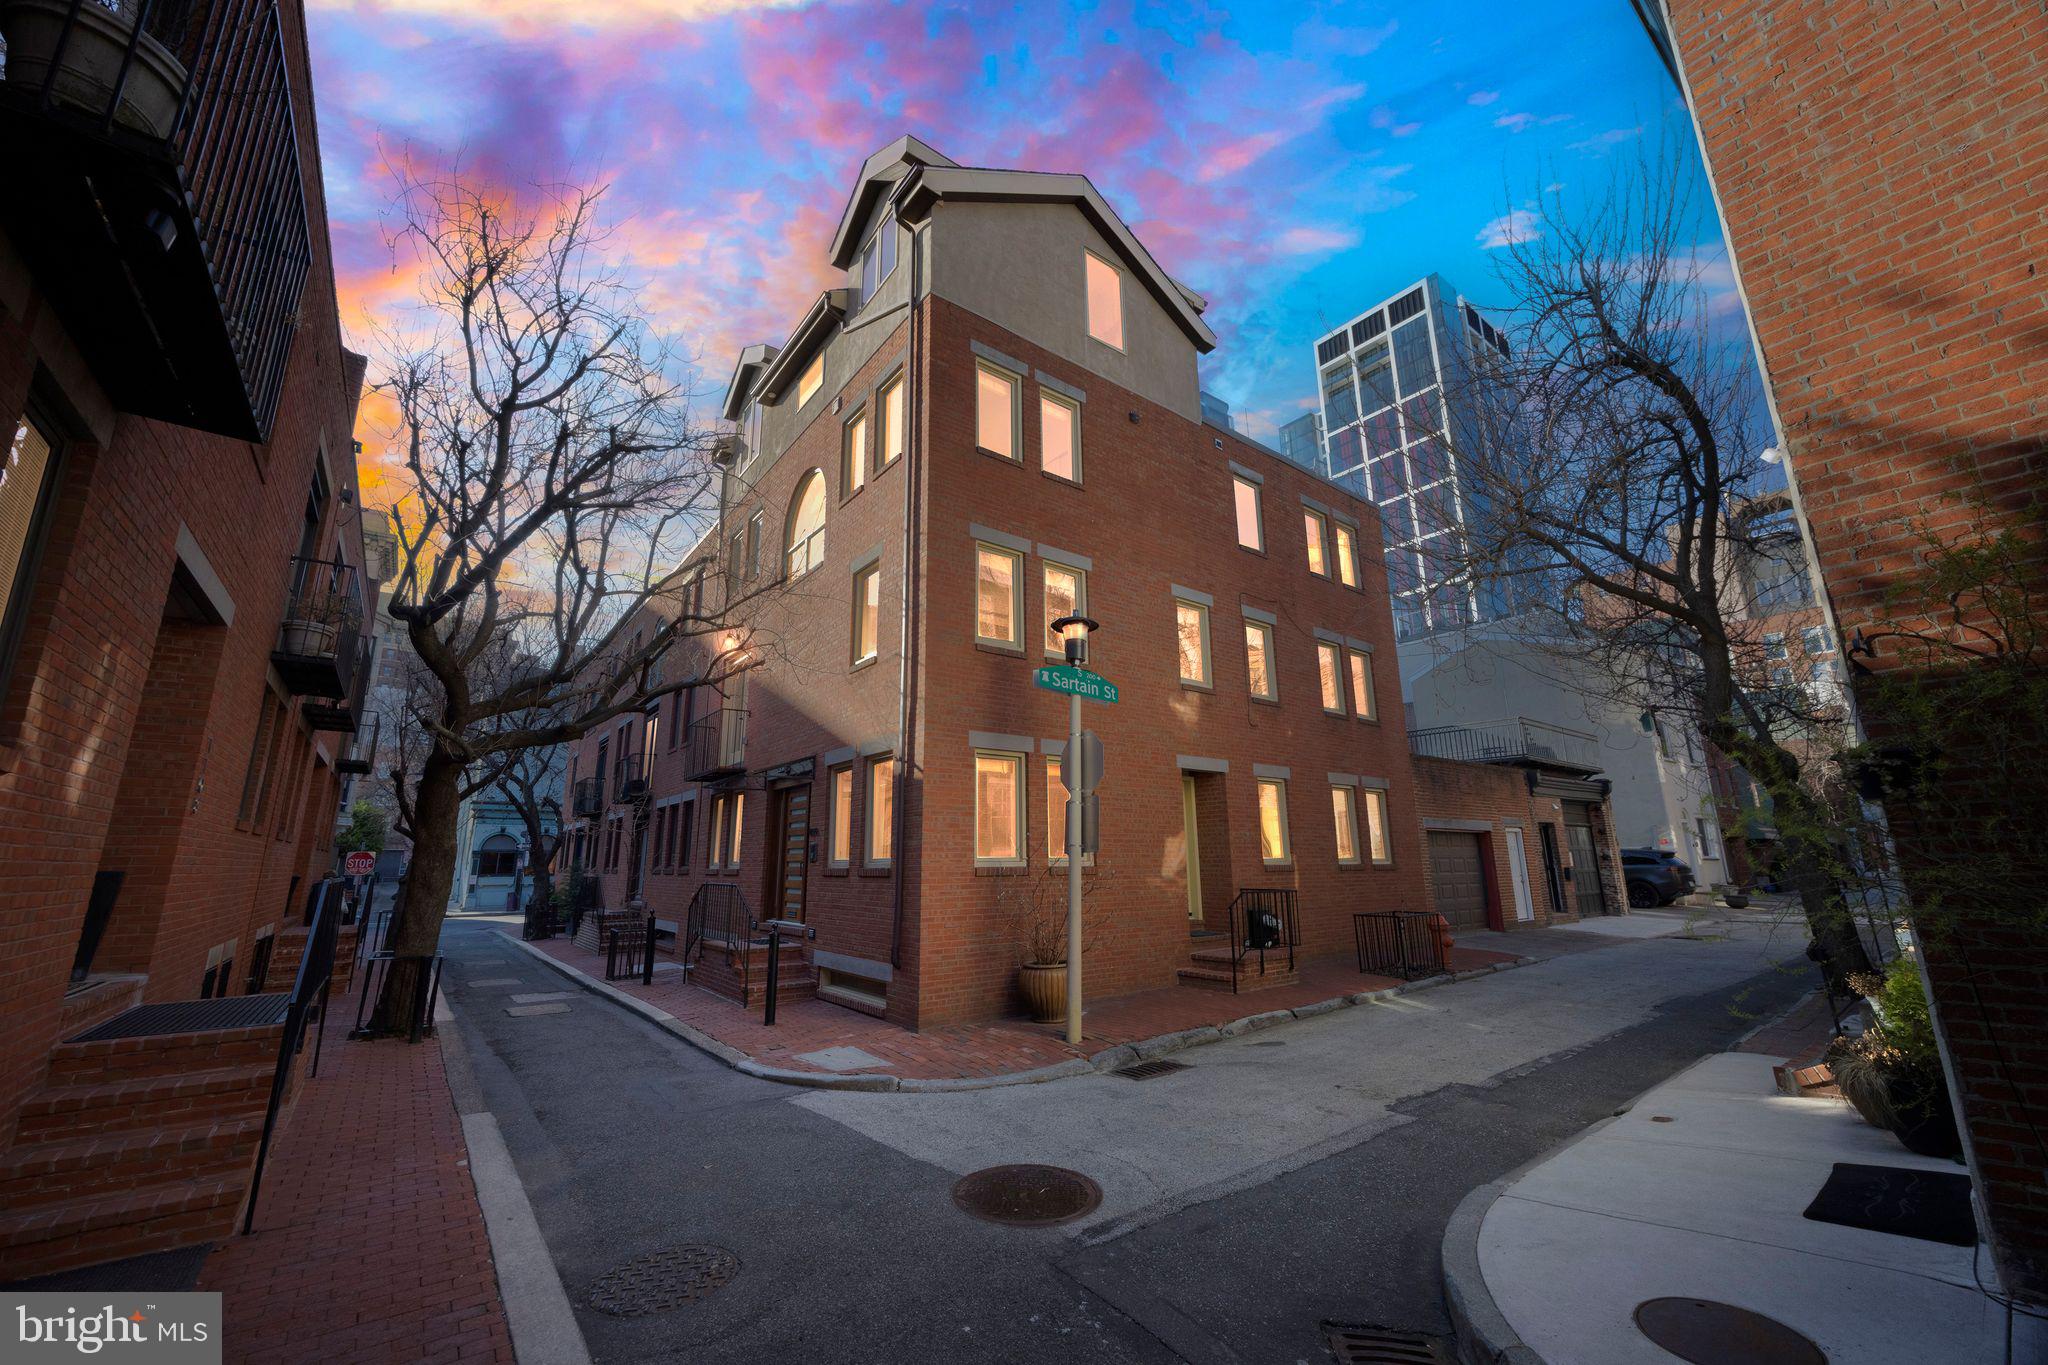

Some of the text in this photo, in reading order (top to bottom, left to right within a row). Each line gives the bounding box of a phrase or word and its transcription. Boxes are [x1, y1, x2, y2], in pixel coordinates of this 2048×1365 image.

[1077, 669, 1082, 677] S
[1052, 672, 1116, 700] Sartain St
[347, 858, 373, 868] STOP
